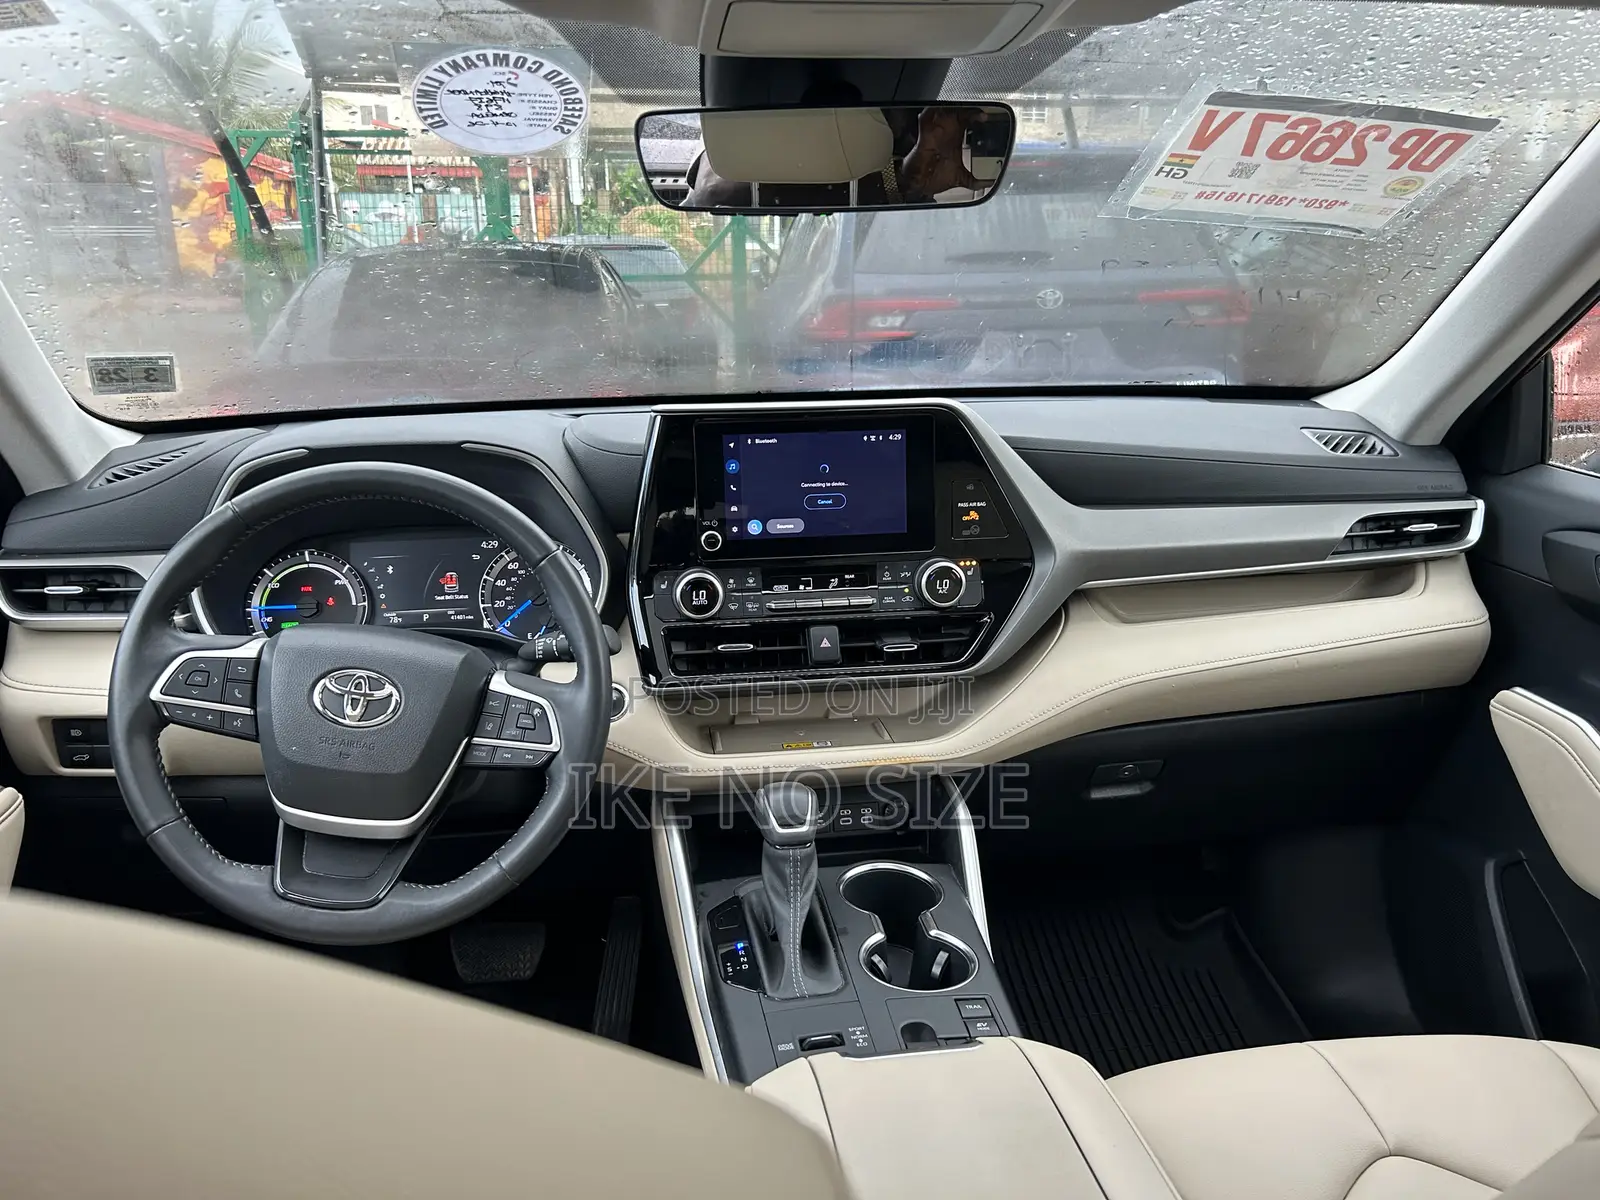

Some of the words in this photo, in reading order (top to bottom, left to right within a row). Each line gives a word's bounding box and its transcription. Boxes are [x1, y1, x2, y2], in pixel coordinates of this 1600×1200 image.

[480, 540, 499, 549] 4:29
[507, 562, 519, 570] 60
[936, 579, 950, 590] LO
[692, 590, 706, 600] LO
[494, 600, 506, 608] 20
[340, 740, 376, 751] AIRBAG
